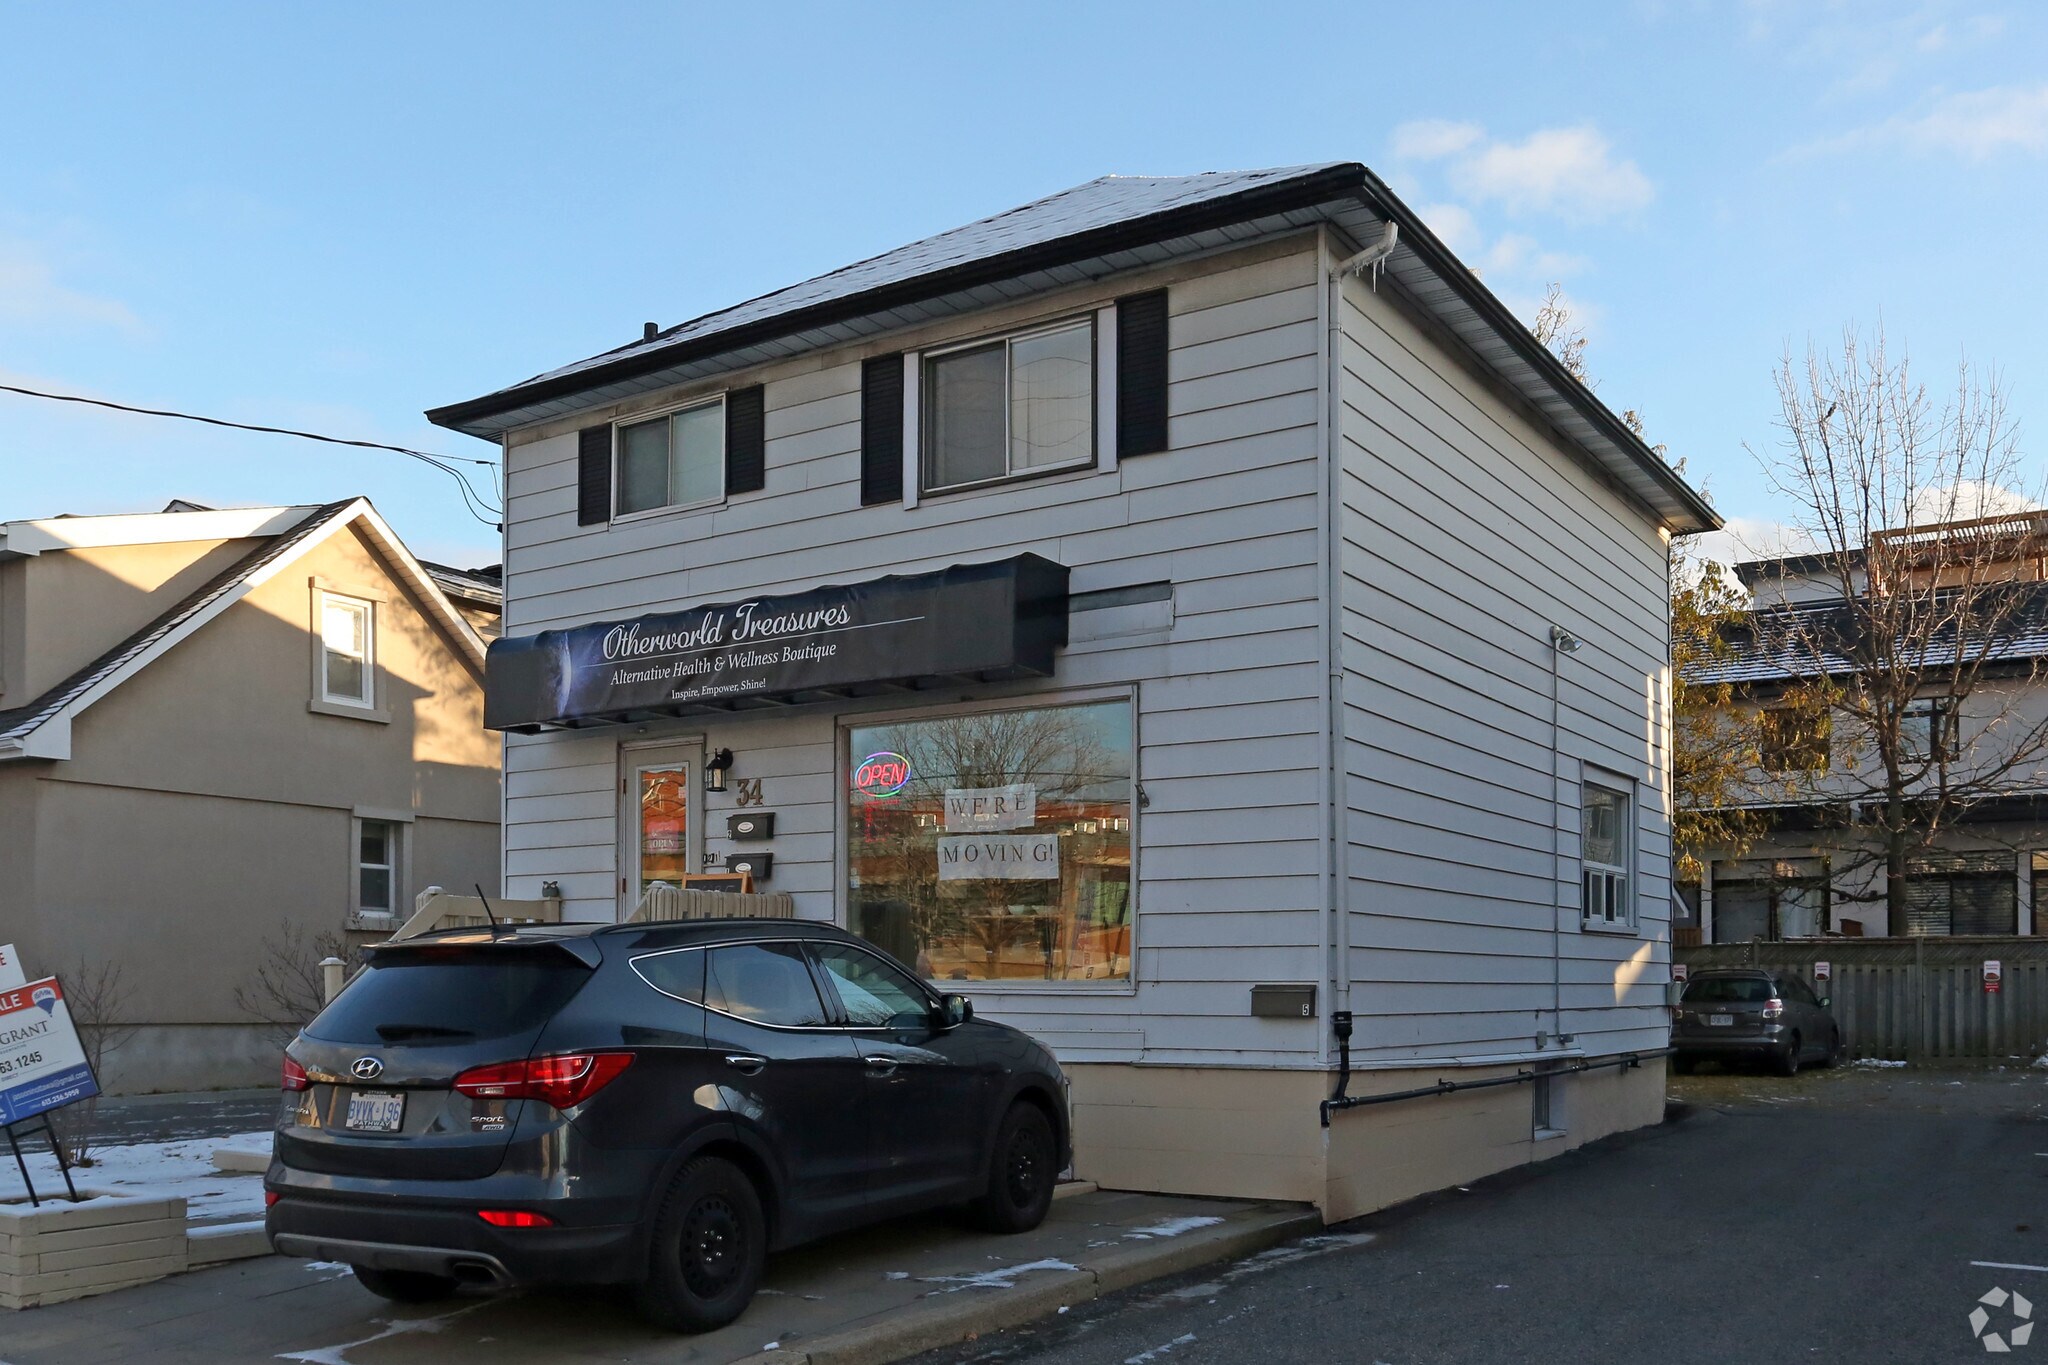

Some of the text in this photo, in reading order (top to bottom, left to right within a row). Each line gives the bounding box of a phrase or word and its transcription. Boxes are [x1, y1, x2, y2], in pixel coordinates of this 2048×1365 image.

[602, 601, 851, 660] Otherworld Treasures
[610, 642, 837, 686] Alternative Health & Wellness Boutique
[671, 677, 766, 700] Inspire, Empower, Shine!
[857, 762, 907, 787] OPEN
[736, 779, 764, 806] 34
[943, 843, 1054, 864] MOVING!
[1303, 1005, 1308, 1015] 5
[0, 1020, 47, 1045] GRANT
[380, 1101, 401, 1121] 196
